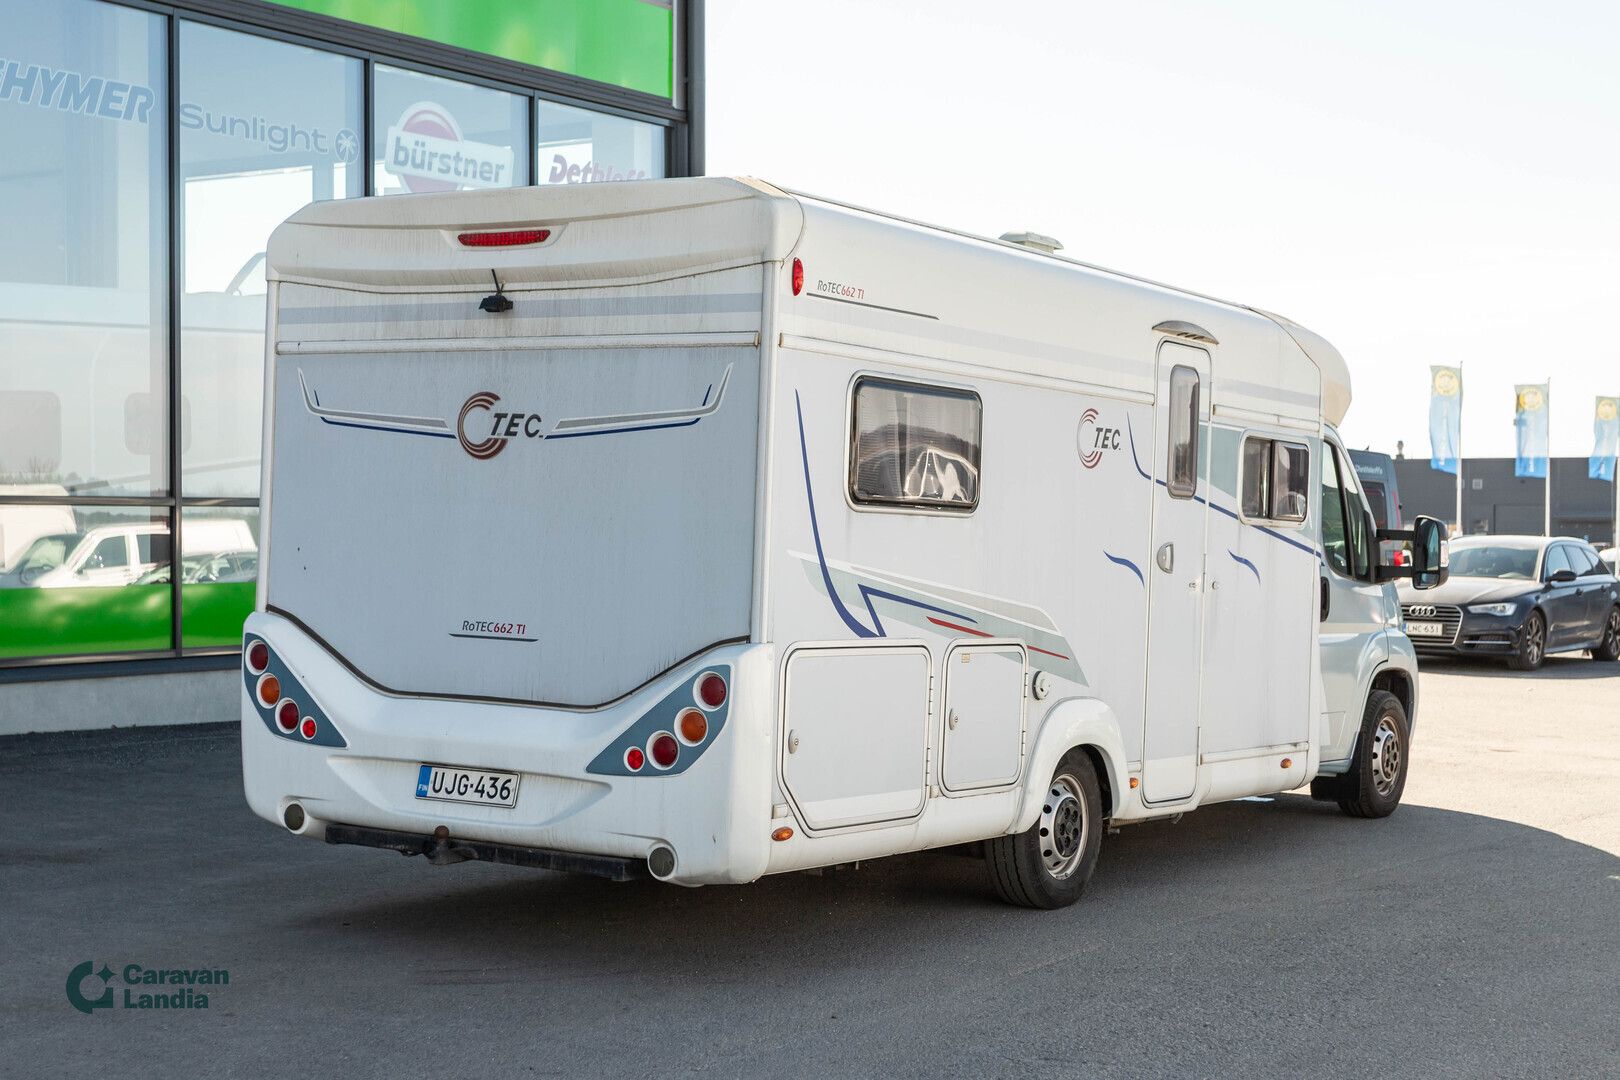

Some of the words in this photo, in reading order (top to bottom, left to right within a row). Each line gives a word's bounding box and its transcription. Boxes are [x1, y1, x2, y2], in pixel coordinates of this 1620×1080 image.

[1, 61, 155, 124] HYMER
[179, 102, 328, 153] Sunlight
[392, 135, 505, 183] bürstner
